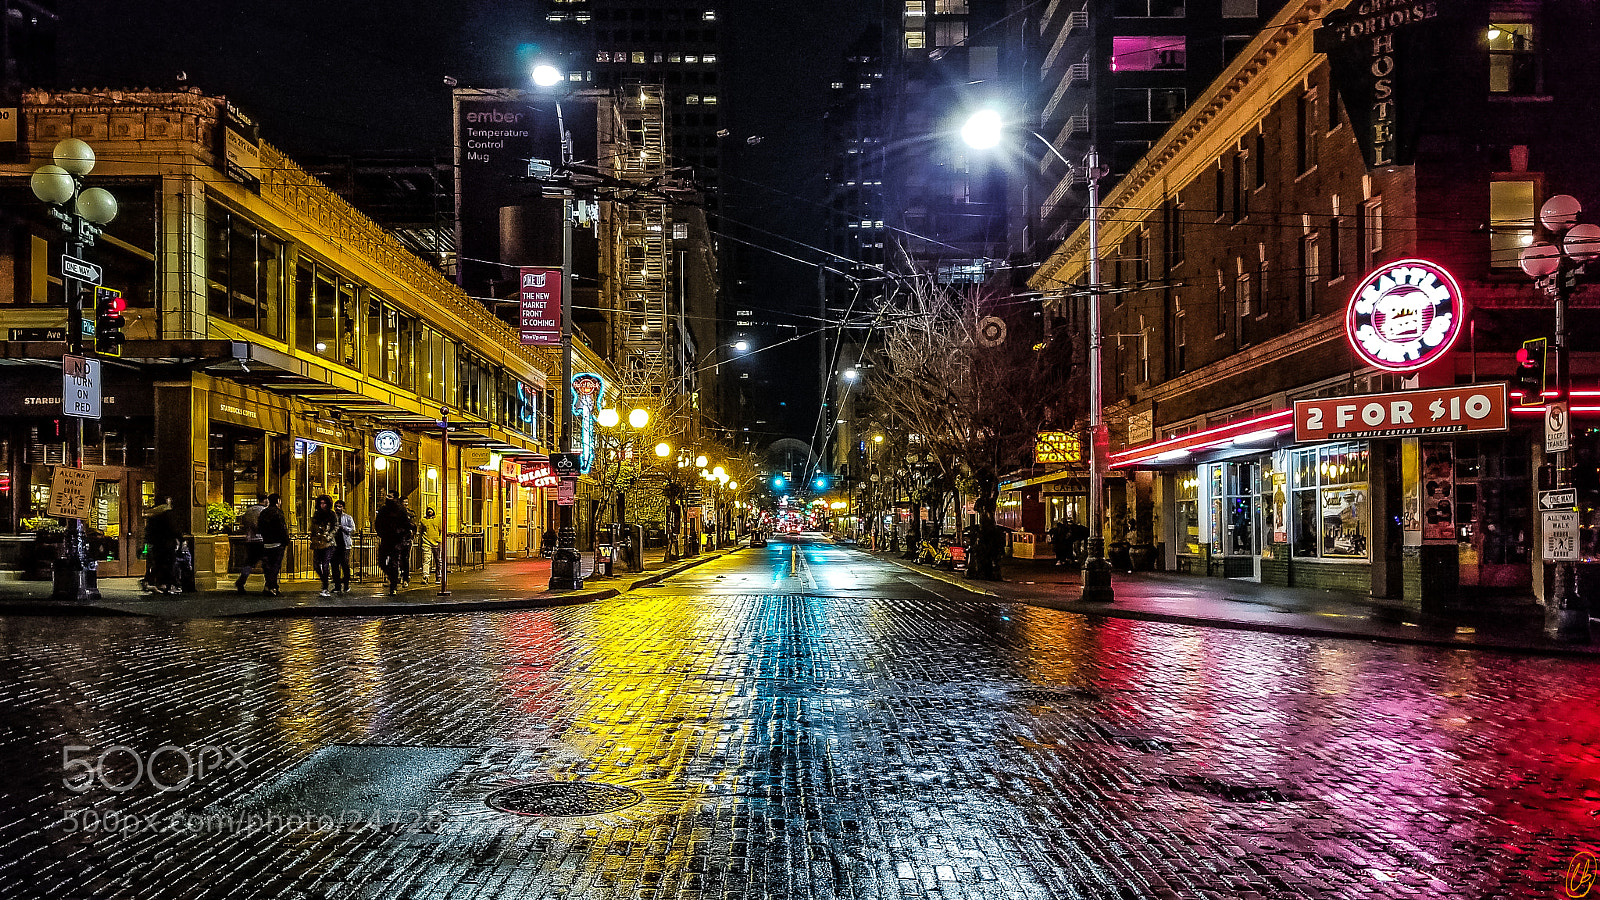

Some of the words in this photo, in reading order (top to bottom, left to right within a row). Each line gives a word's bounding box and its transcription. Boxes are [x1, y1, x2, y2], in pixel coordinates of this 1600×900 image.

[1371, 33, 1395, 167] HOSTEL
[466, 108, 525, 123] ember
[467, 127, 529, 139] Temperature
[467, 139, 504, 149] Control
[467, 151, 490, 163] Mug
[66, 261, 78, 274] ONE
[78, 265, 90, 277] WAY
[523, 292, 535, 300] THE
[535, 292, 550, 300] NEW
[522, 301, 548, 309] MARKET
[522, 309, 543, 318] FRONT
[522, 318, 528, 326] IS
[46, 330, 61, 339] Ave
[74, 361, 91, 375] NO
[73, 376, 93, 388] TURN
[77, 389, 89, 400] ON
[24, 397, 63, 405] STARBU
[74, 401, 91, 413] RED
[1307, 408, 1324, 430] 2
[1336, 400, 1414, 428] FOR
[1428, 394, 1491, 422] $10
[1356, 429, 1382, 438] WHITE
[1547, 432, 1566, 441] EXCEPT
[1547, 440, 1567, 449] TRANSIT
[64, 478, 84, 487] WALK
[1550, 495, 1560, 504] ONE
[1560, 494, 1573, 503] WAY
[1559, 514, 1574, 522] WAY
